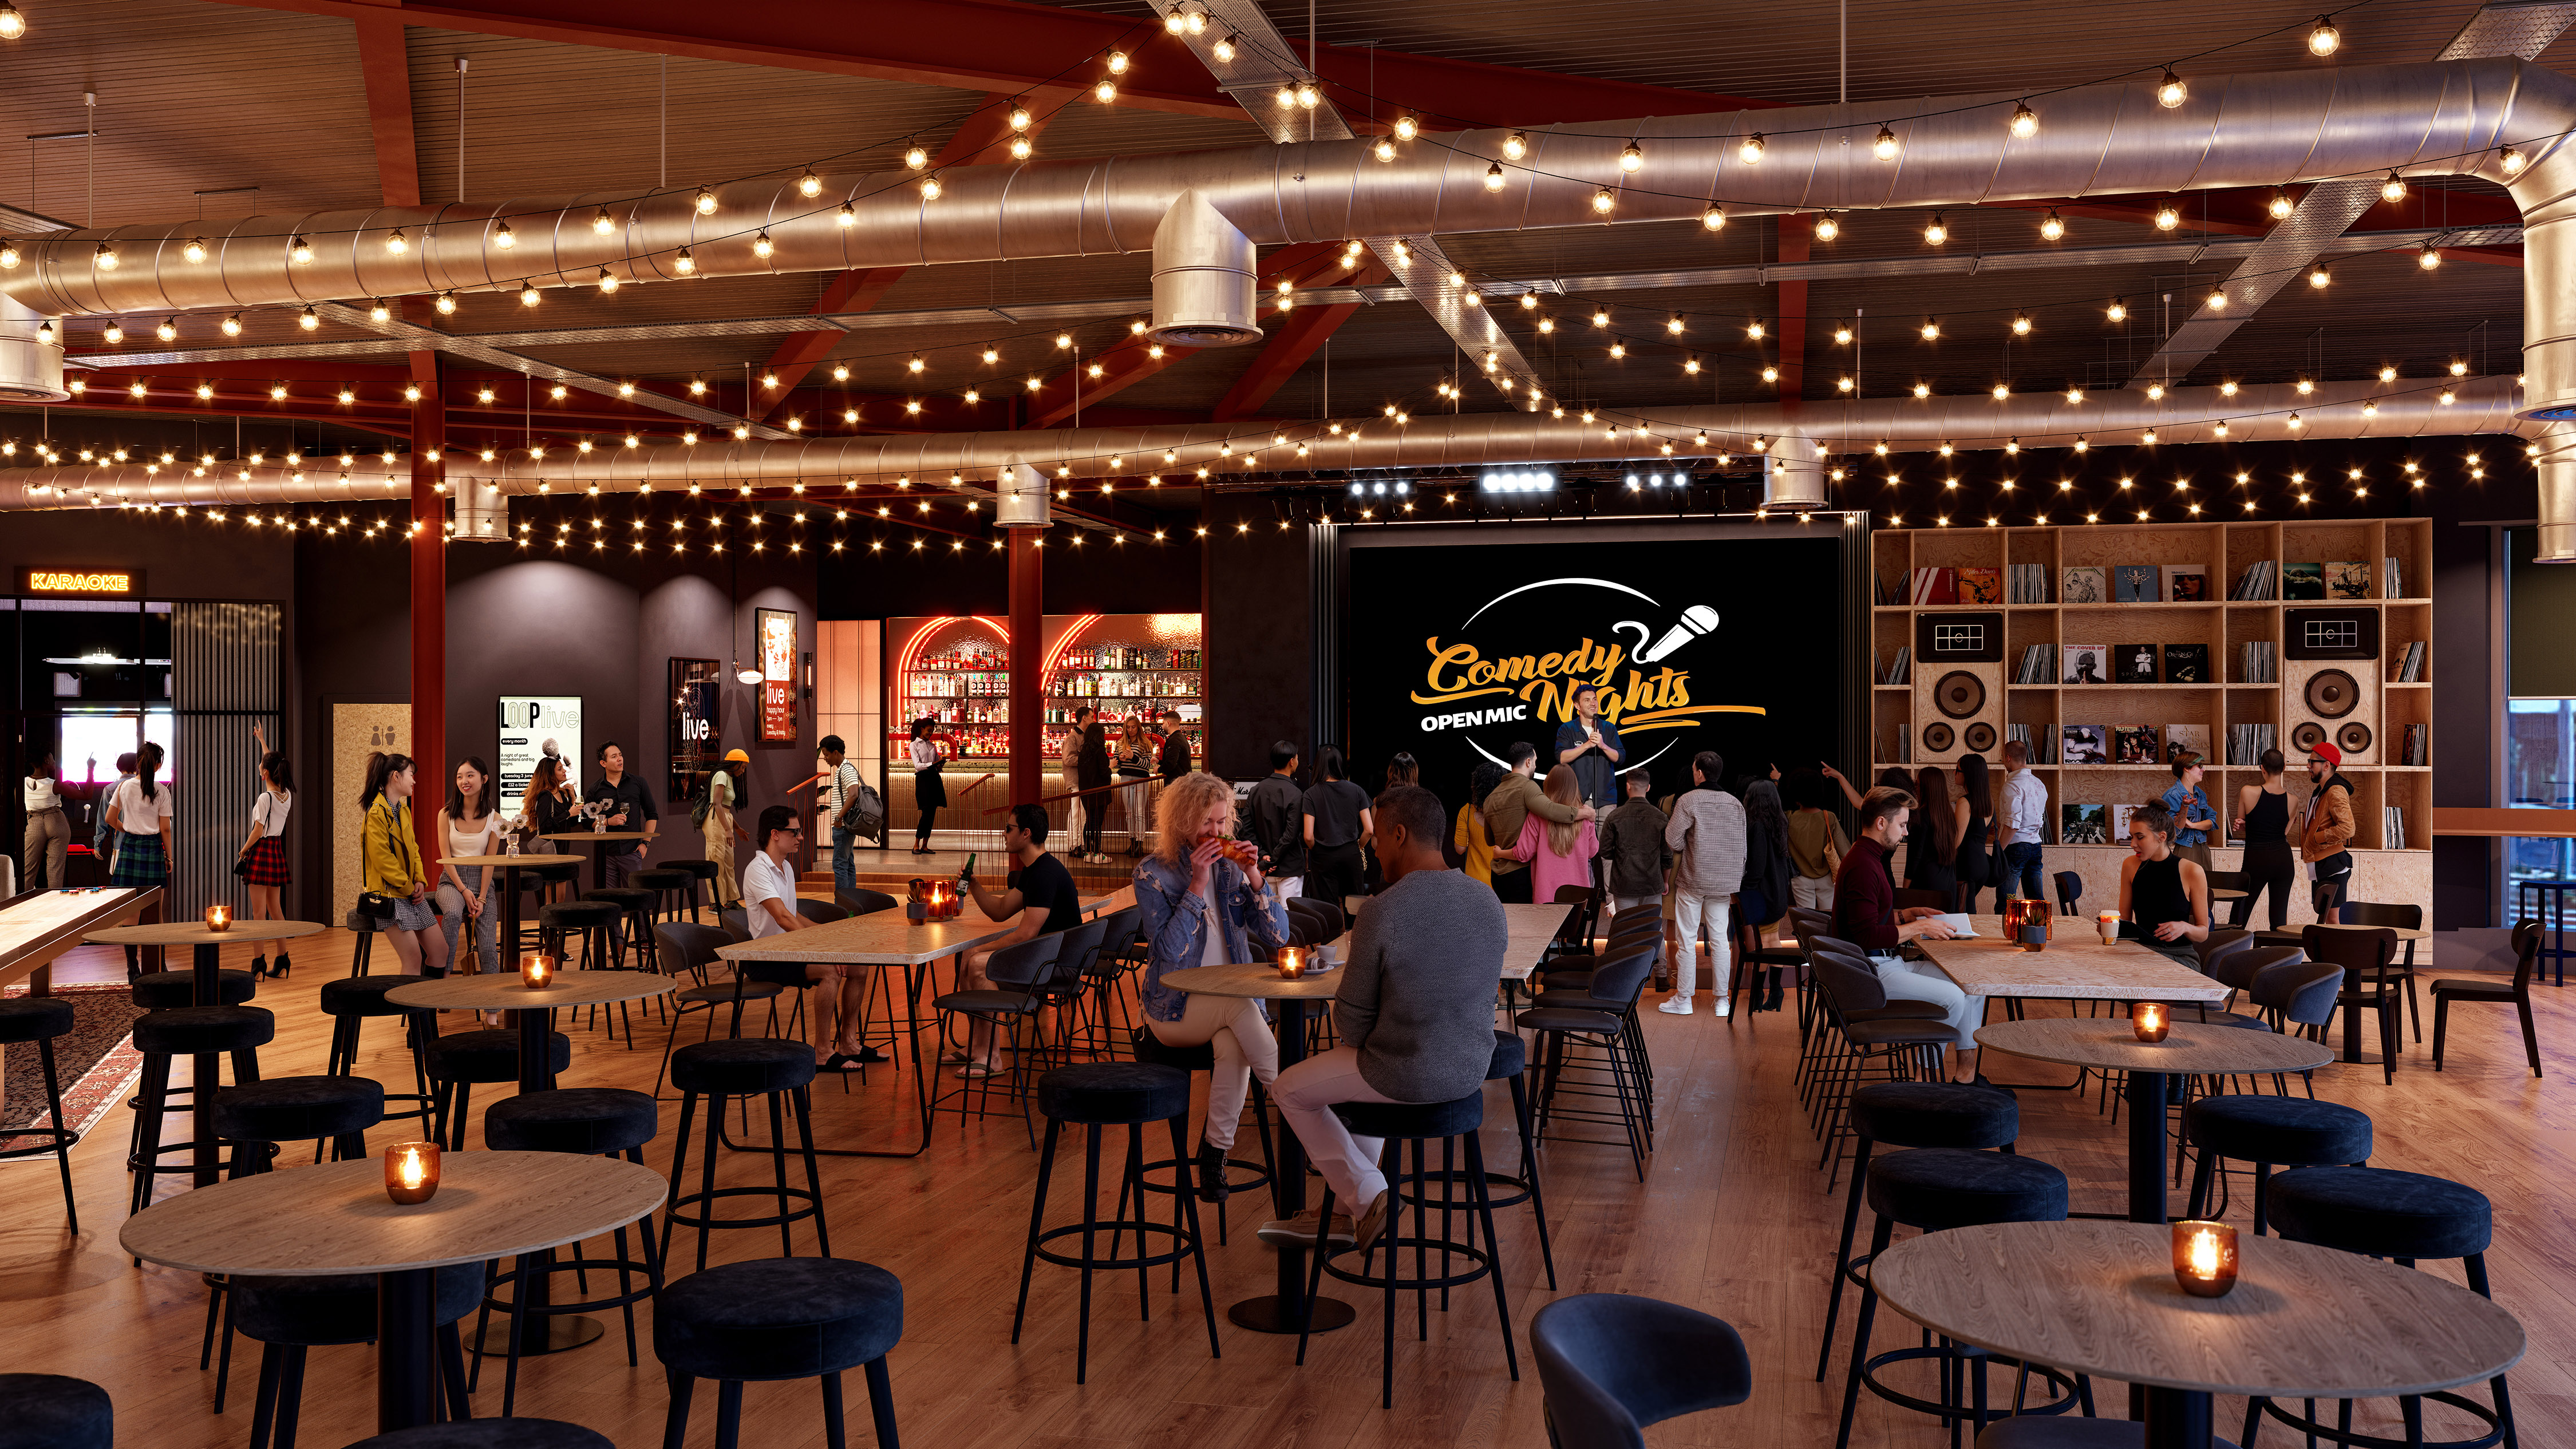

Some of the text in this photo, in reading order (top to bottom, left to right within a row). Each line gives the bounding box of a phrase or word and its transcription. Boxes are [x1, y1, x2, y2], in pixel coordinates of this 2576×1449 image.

[31, 573, 128, 591] KARAOKE
[1426, 636, 1626, 692] Comedy
[767, 682, 784, 704] live
[1519, 667, 1690, 725] Nghts
[767, 706, 777, 715] happy
[1421, 704, 1527, 731] OPEN MIC
[682, 712, 709, 740] live
[1236, 786, 1250, 794] Mar
